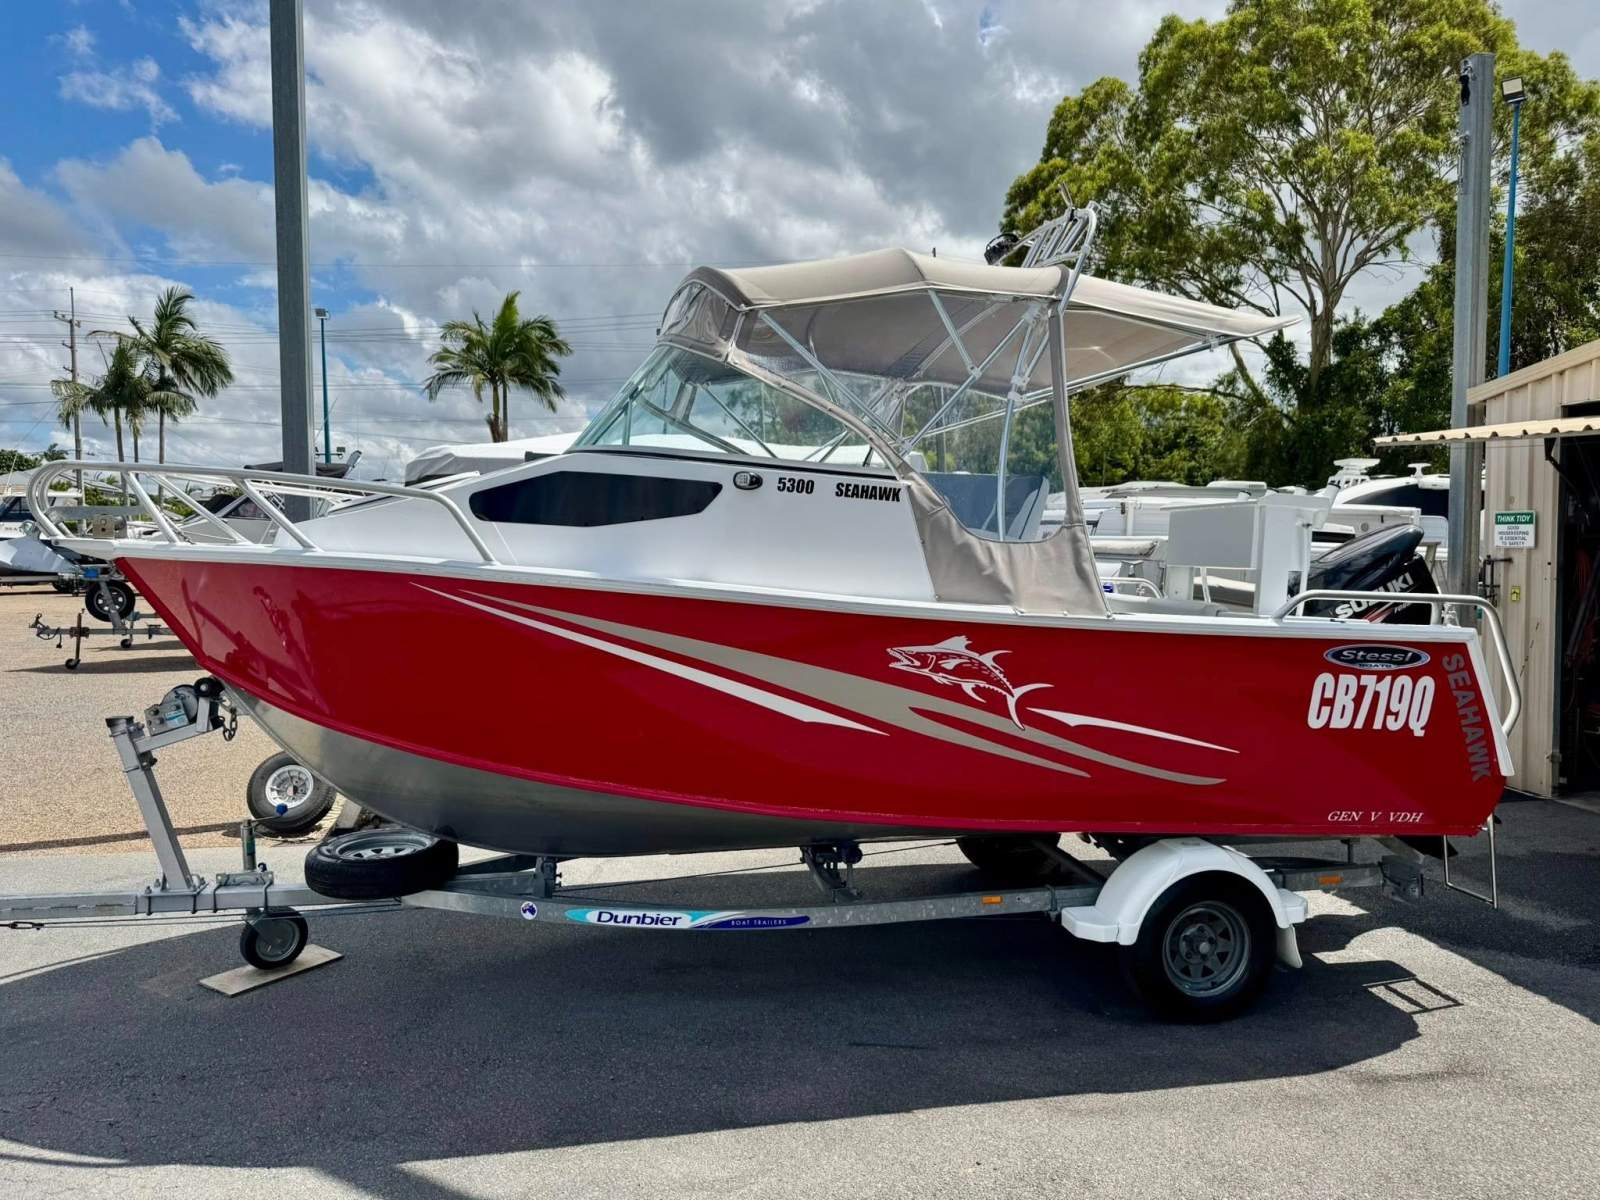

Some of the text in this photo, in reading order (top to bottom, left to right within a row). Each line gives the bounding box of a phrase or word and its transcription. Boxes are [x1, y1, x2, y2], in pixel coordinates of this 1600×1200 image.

[777, 477, 901, 502] 5300 SEAHAWK
[1340, 650, 1413, 662] Stessl
[1307, 672, 1435, 736] CB719Q
[1441, 654, 1490, 782] SEAHAWK
[1327, 811, 1424, 823] GEN V VDH
[597, 911, 681, 926] Dunbier
